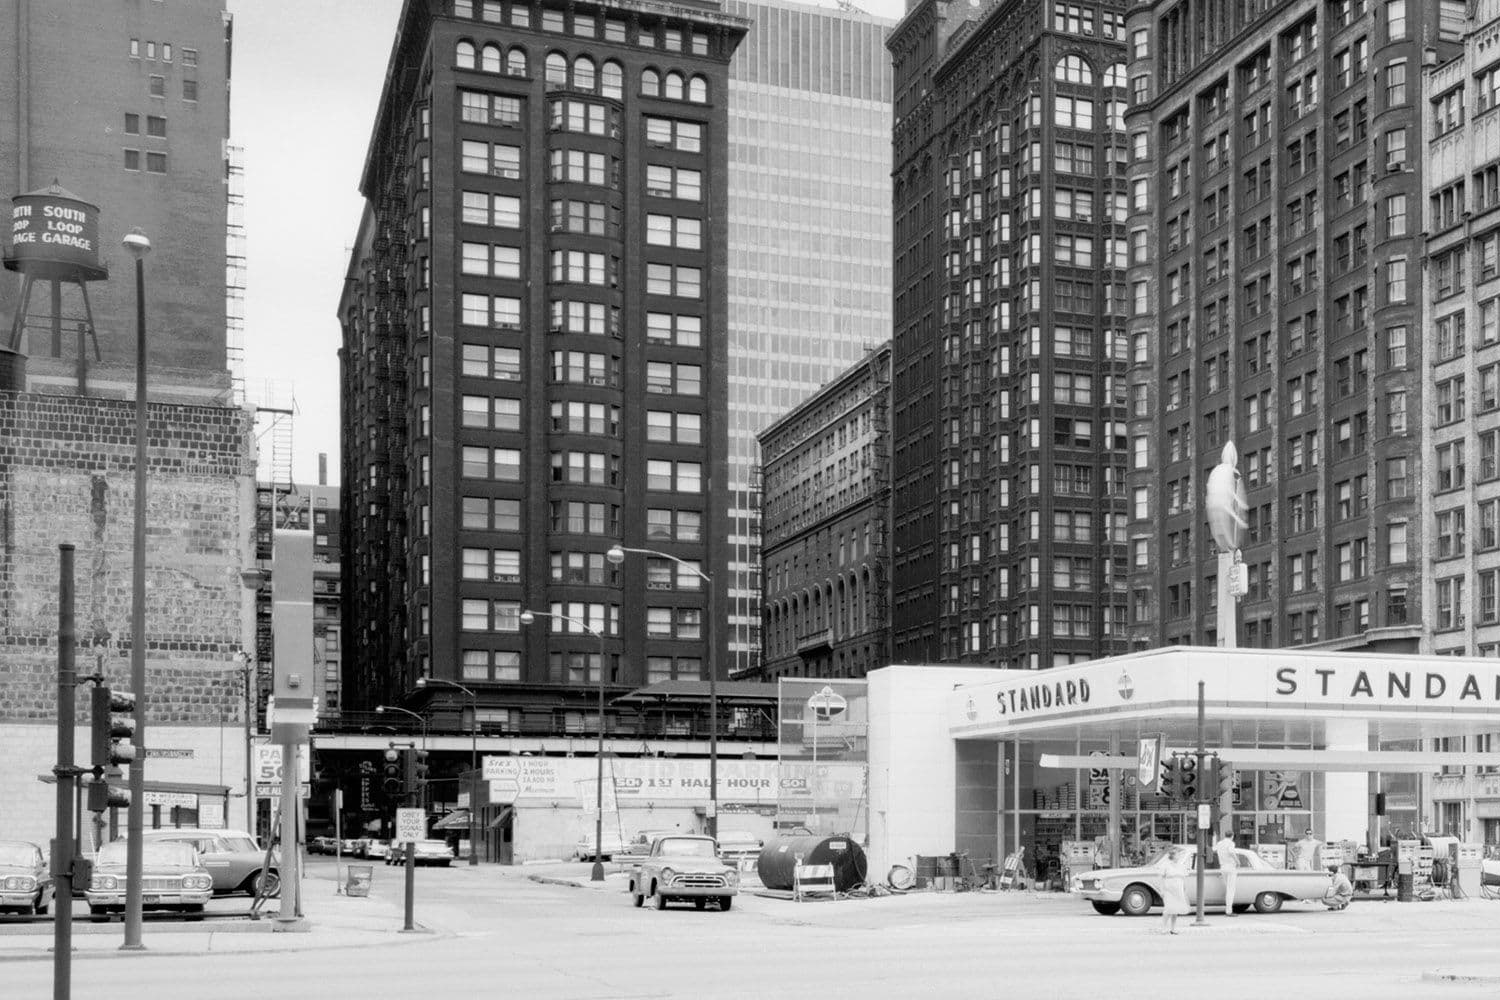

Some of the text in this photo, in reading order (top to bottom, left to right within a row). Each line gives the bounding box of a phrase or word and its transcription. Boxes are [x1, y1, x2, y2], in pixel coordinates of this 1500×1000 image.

[43, 205, 86, 223] SOUTH
[47, 220, 83, 234] LOOP
[41, 232, 92, 251] GARAGE
[997, 678, 1091, 715] STANDARD
[260, 749, 305, 760] PAK
[648, 779, 672, 788] 1ST
[727, 779, 770, 788] HOUR
